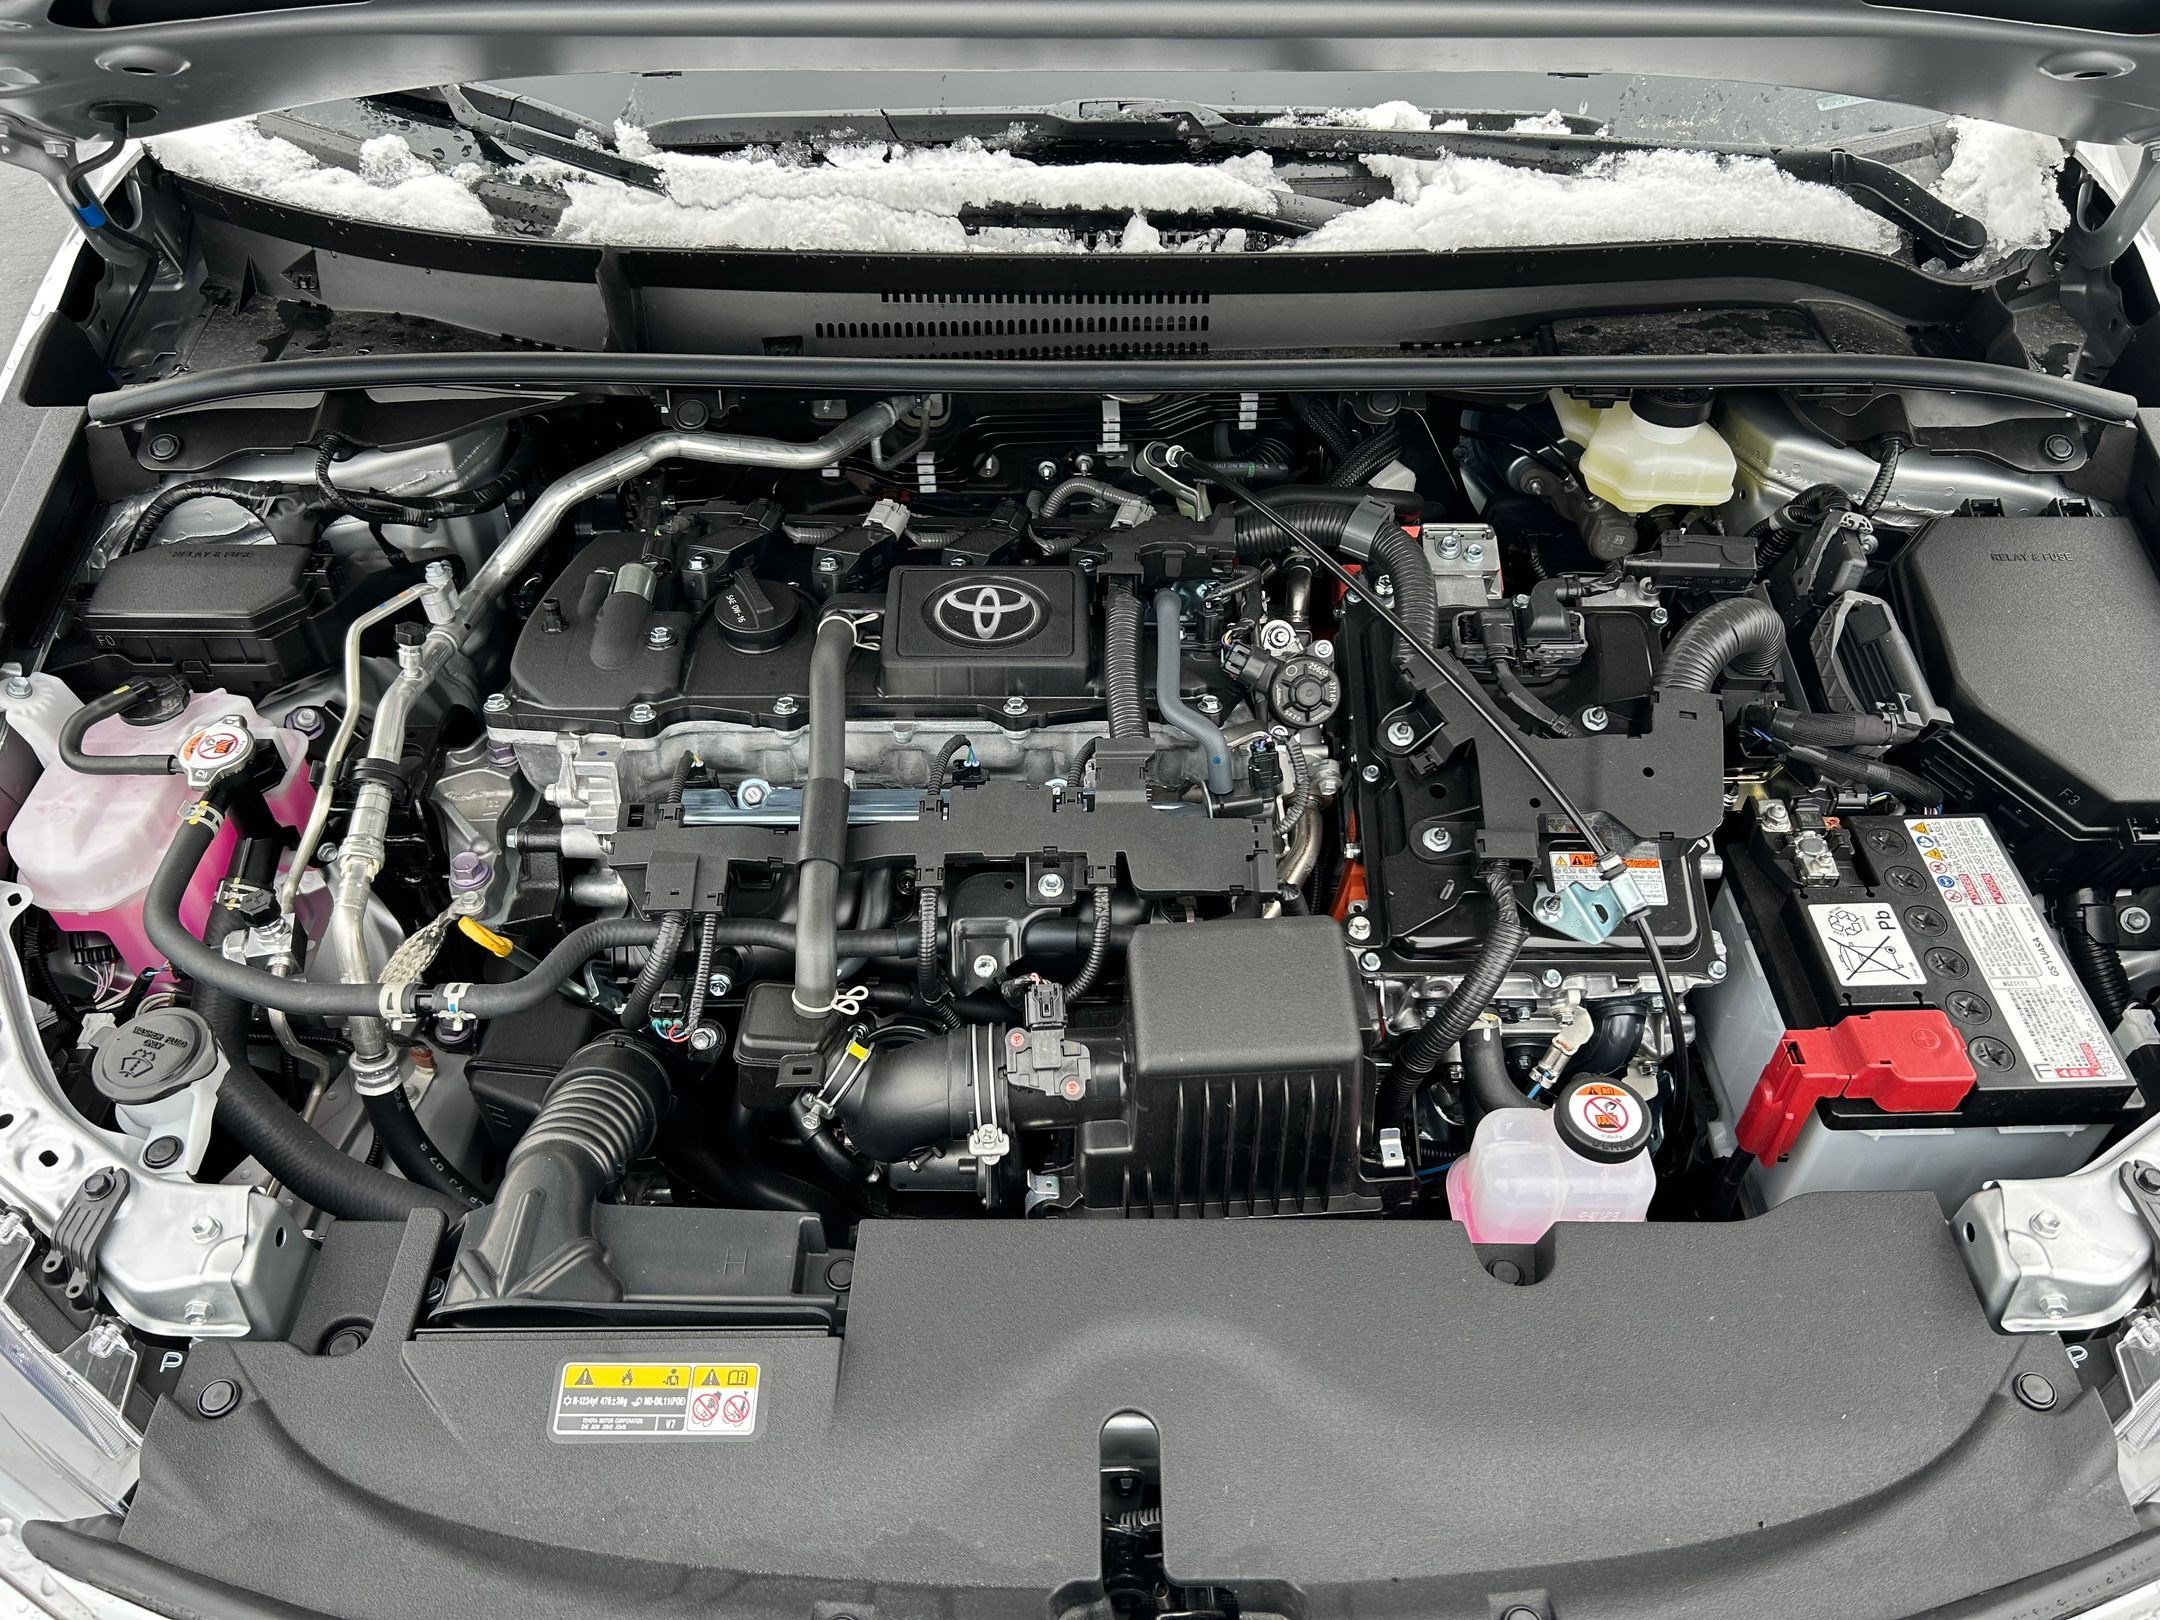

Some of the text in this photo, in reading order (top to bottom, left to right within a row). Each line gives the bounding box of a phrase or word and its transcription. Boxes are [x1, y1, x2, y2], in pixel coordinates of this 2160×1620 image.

[1989, 552, 2074, 562] RELAY & FUSE
[725, 593, 738, 606] SAE
[1328, 681, 1337, 702] 37140
[2058, 787, 2081, 806] F3
[1875, 910, 1897, 930] Pb
[143, 1039, 165, 1051] ONLY
[159, 1351, 184, 1373] P
[572, 1395, 599, 1408] R-1234yf
[665, 1418, 677, 1430] V7
